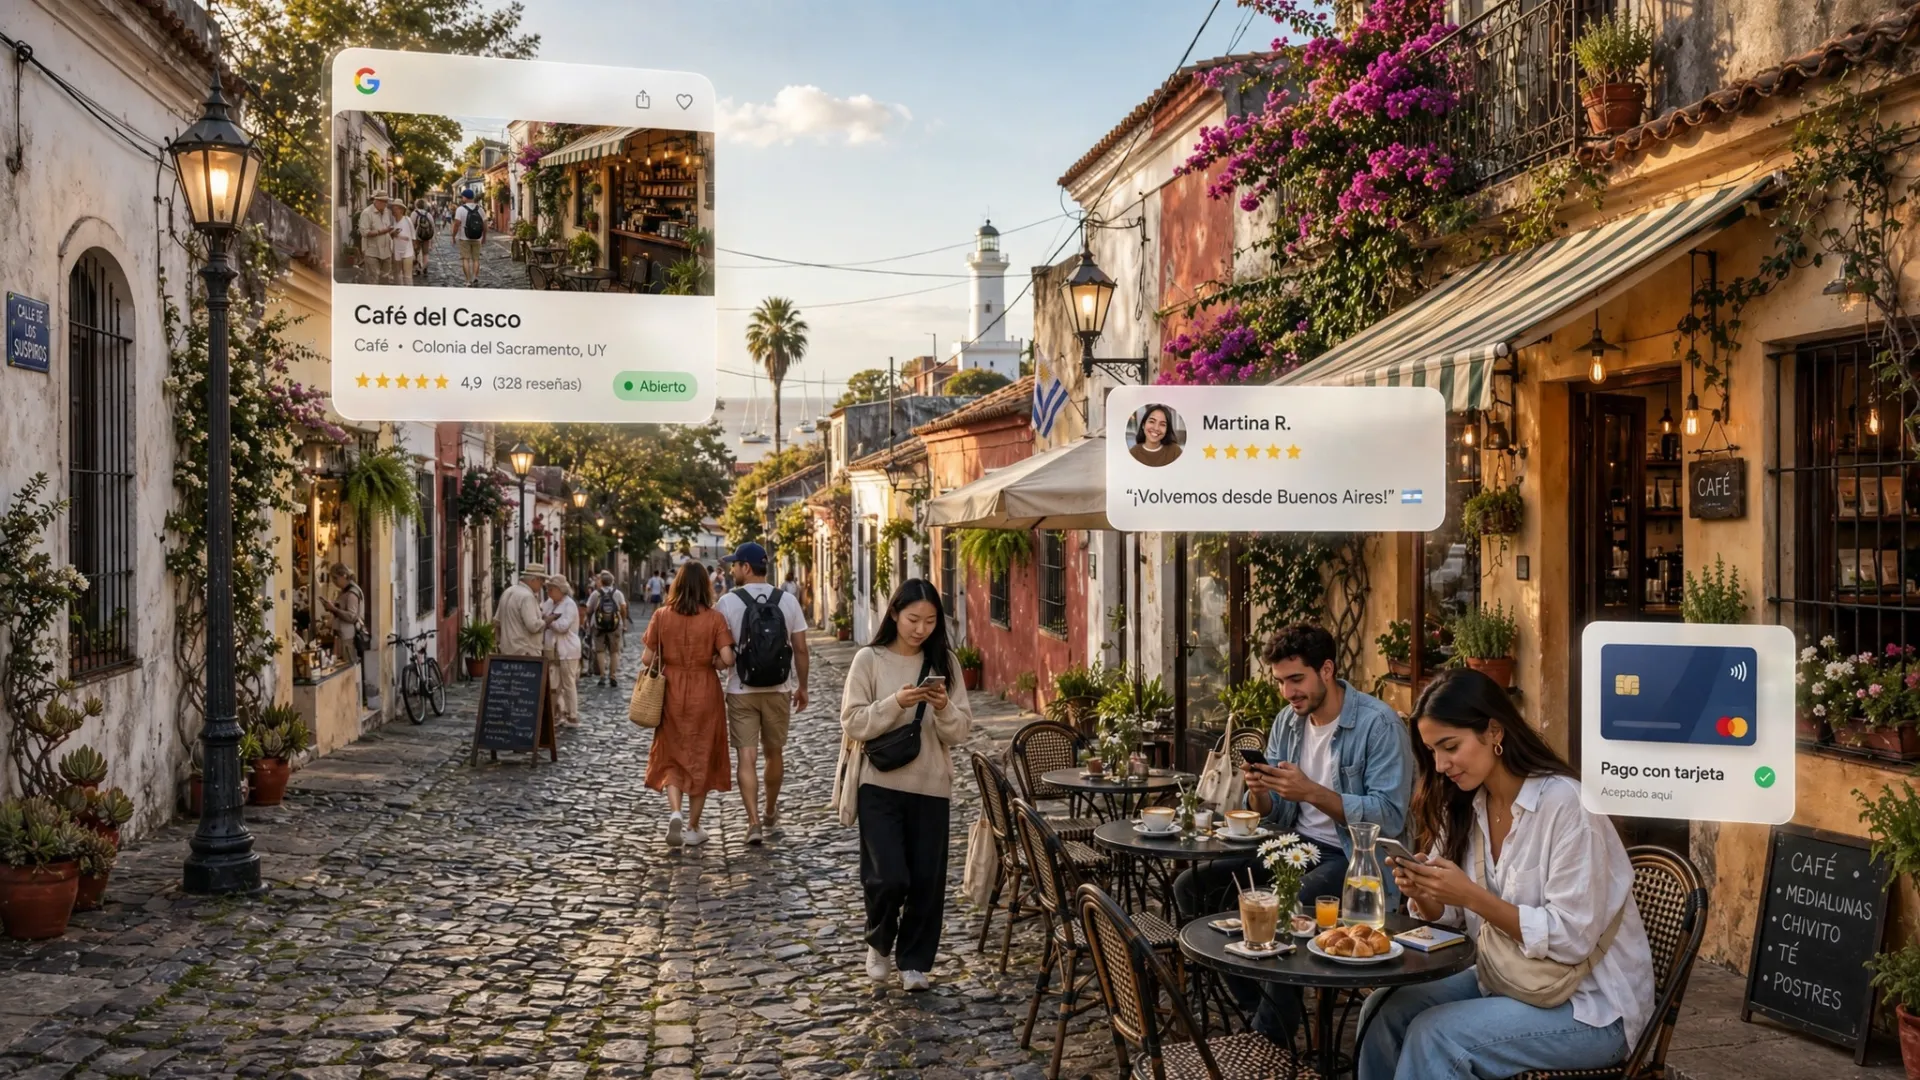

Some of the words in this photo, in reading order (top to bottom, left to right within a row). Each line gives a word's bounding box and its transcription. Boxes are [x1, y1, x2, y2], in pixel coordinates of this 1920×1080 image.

[18, 304, 34, 321] CALLE
[36, 310, 43, 323] DE
[25, 323, 36, 338] LOS
[14, 338, 46, 362] SUSPIROS
[1698, 471, 1731, 496] CAFÉ
[1791, 852, 1838, 880] CAFÉ
[1786, 884, 1872, 920] MEDIALUNAS
[1782, 914, 1841, 943] CHIVITO
[1778, 942, 1800, 965] TÉ
[1774, 972, 1842, 1010] POSTRES
